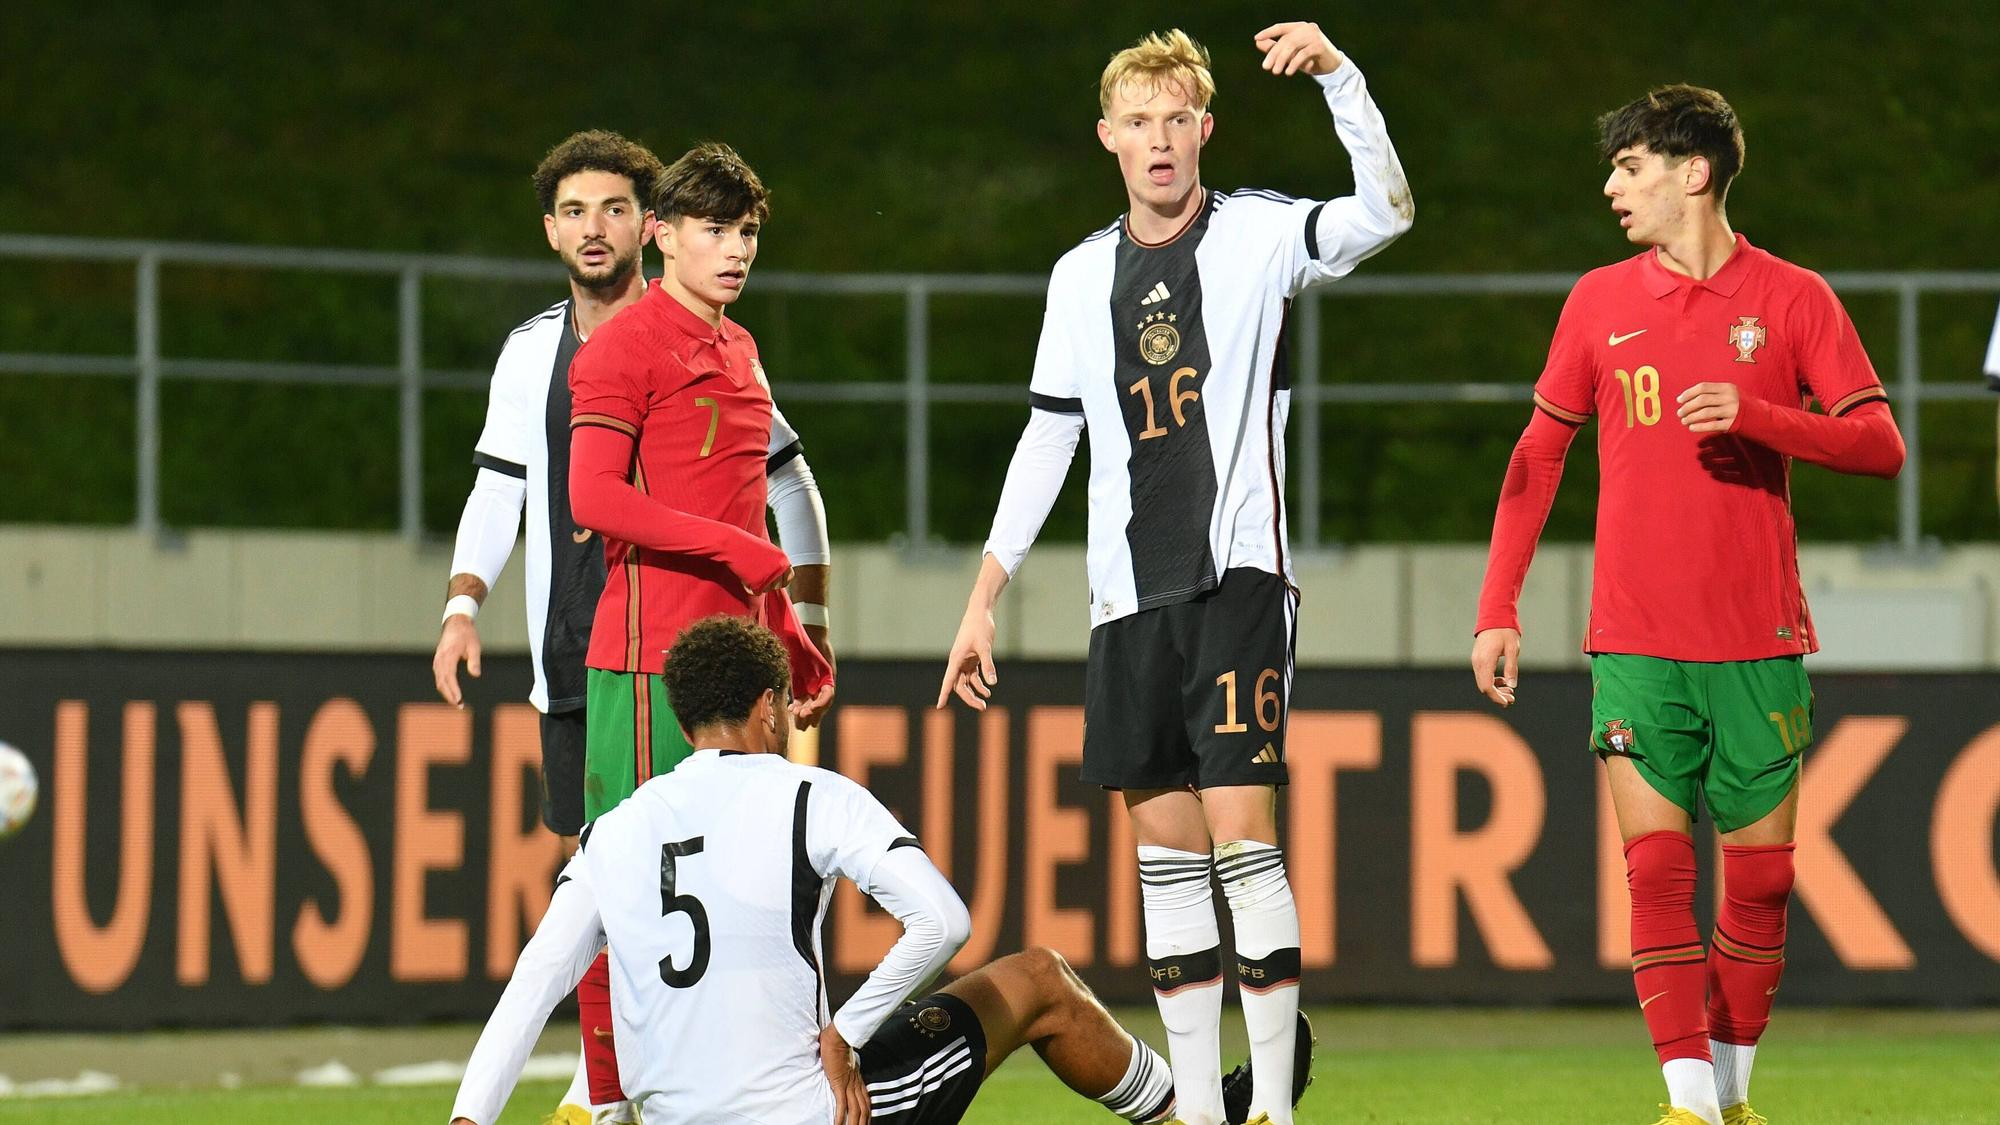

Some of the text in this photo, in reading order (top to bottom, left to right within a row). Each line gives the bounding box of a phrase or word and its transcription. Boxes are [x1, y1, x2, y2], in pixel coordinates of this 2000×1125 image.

[695, 397, 720, 457] 7
[1130, 367, 1200, 441] 16
[1614, 366, 1662, 428] 18
[1215, 668, 1281, 734] 16
[788, 705, 1140, 973] EUE
[658, 835, 711, 989] 5
[1149, 965, 1182, 982] DFB
[1237, 962, 1265, 979] DFB
